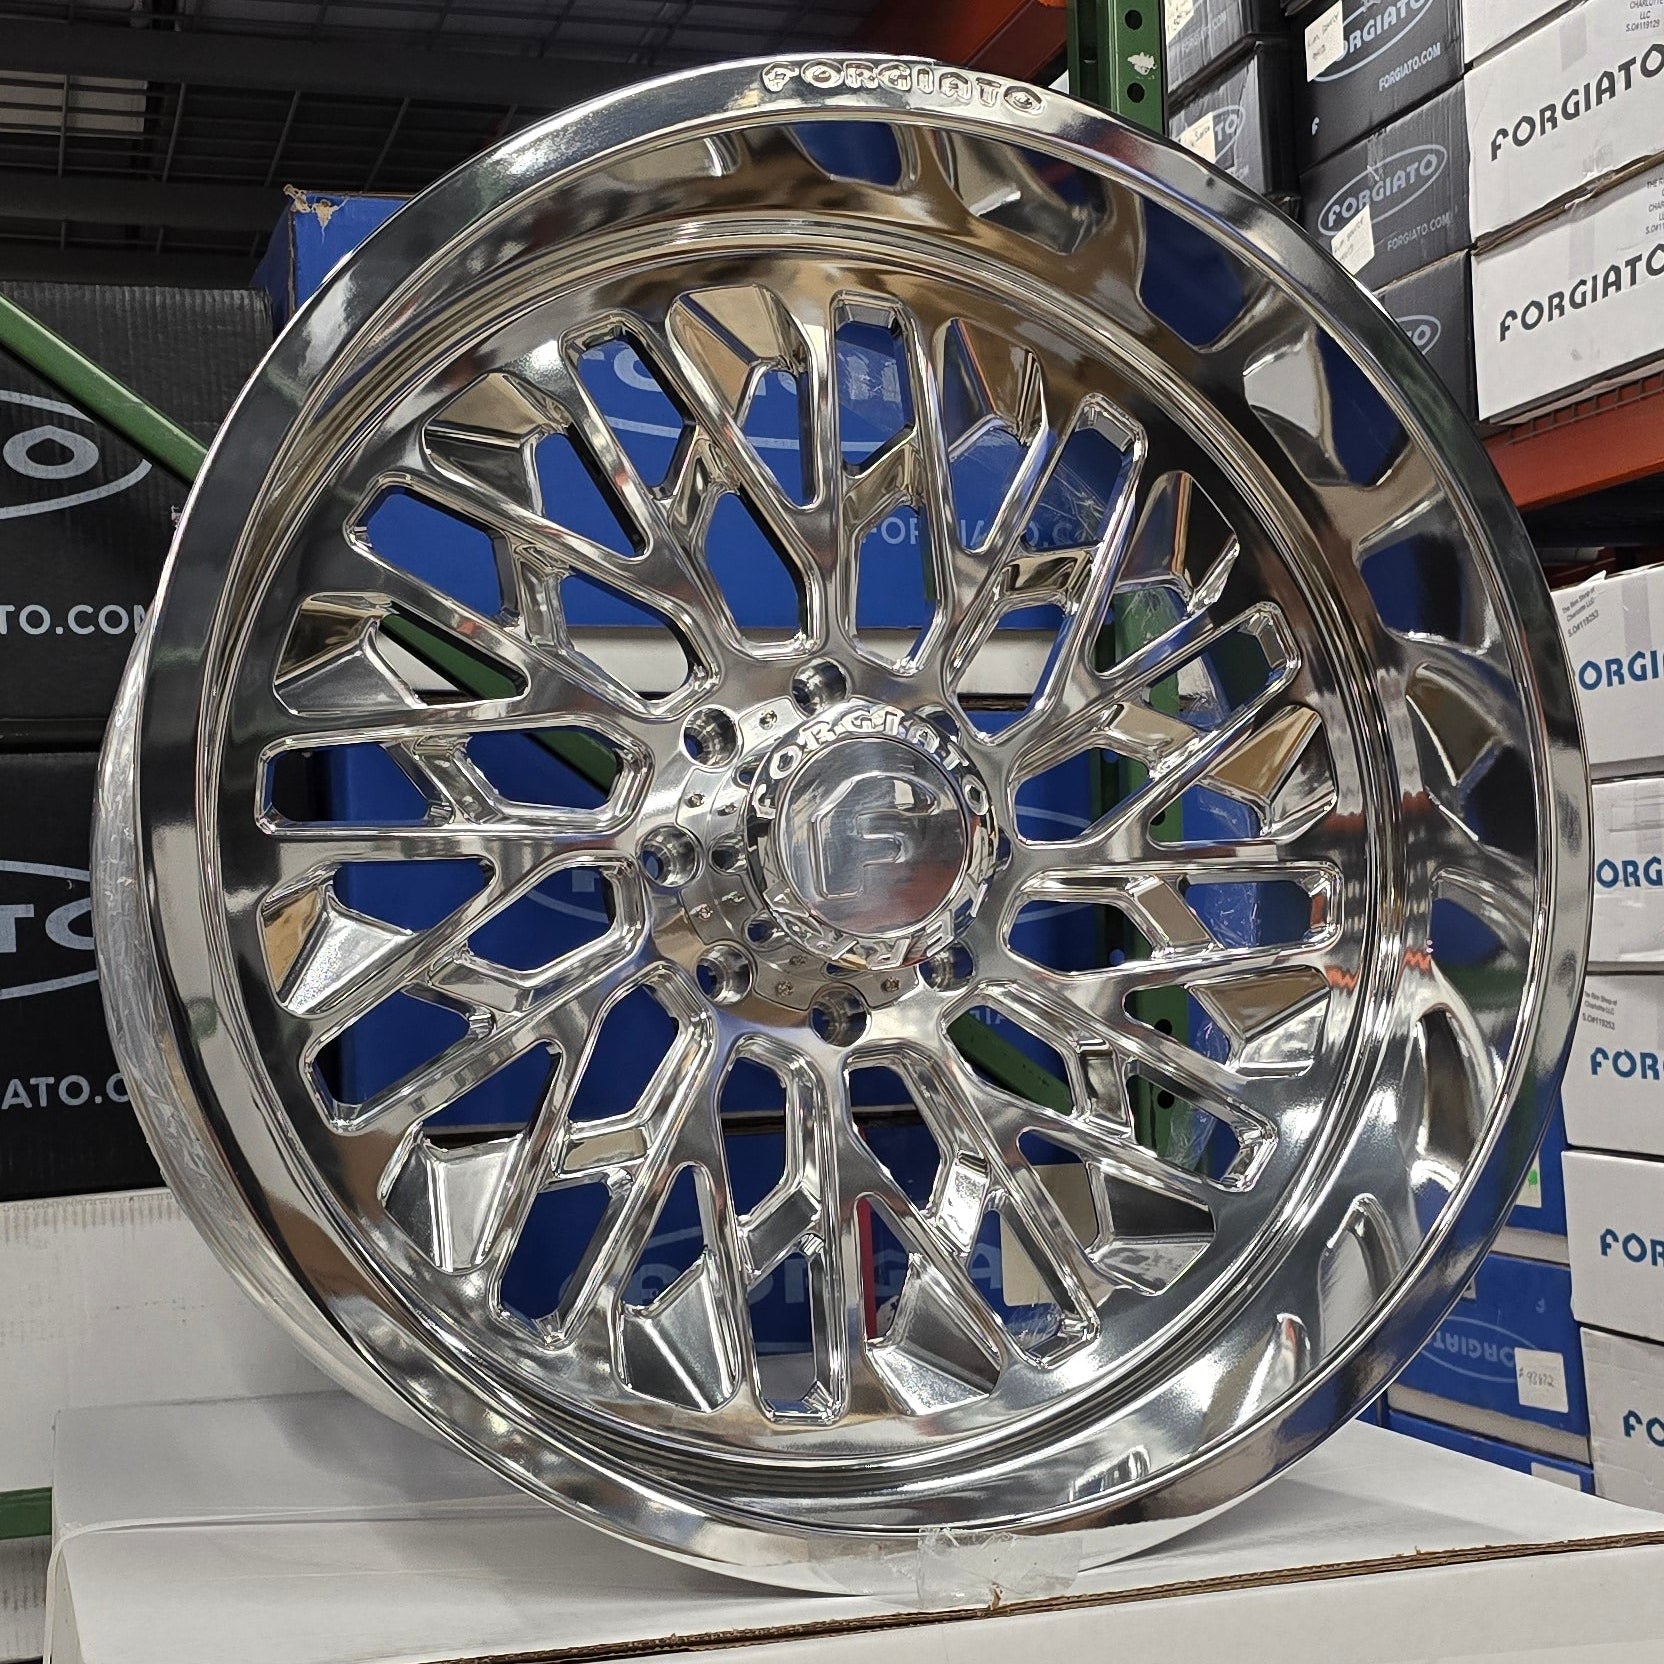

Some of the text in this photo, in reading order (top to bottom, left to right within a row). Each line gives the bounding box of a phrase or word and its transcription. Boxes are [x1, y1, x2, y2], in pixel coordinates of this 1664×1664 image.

[760, 58, 1046, 115] FORGIATO
[1378, 42, 1441, 92] FORGIATO.COM
[1490, 43, 1664, 162] FORGIATO
[1328, 153, 1438, 228] FORGIATO
[1387, 211, 1452, 252] FORGIATO.COM
[1499, 244, 1664, 342] FORGIATO
[1571, 650, 1664, 690] ORGI
[1596, 856, 1664, 888] ORG
[1590, 1046, 1664, 1080] FOR
